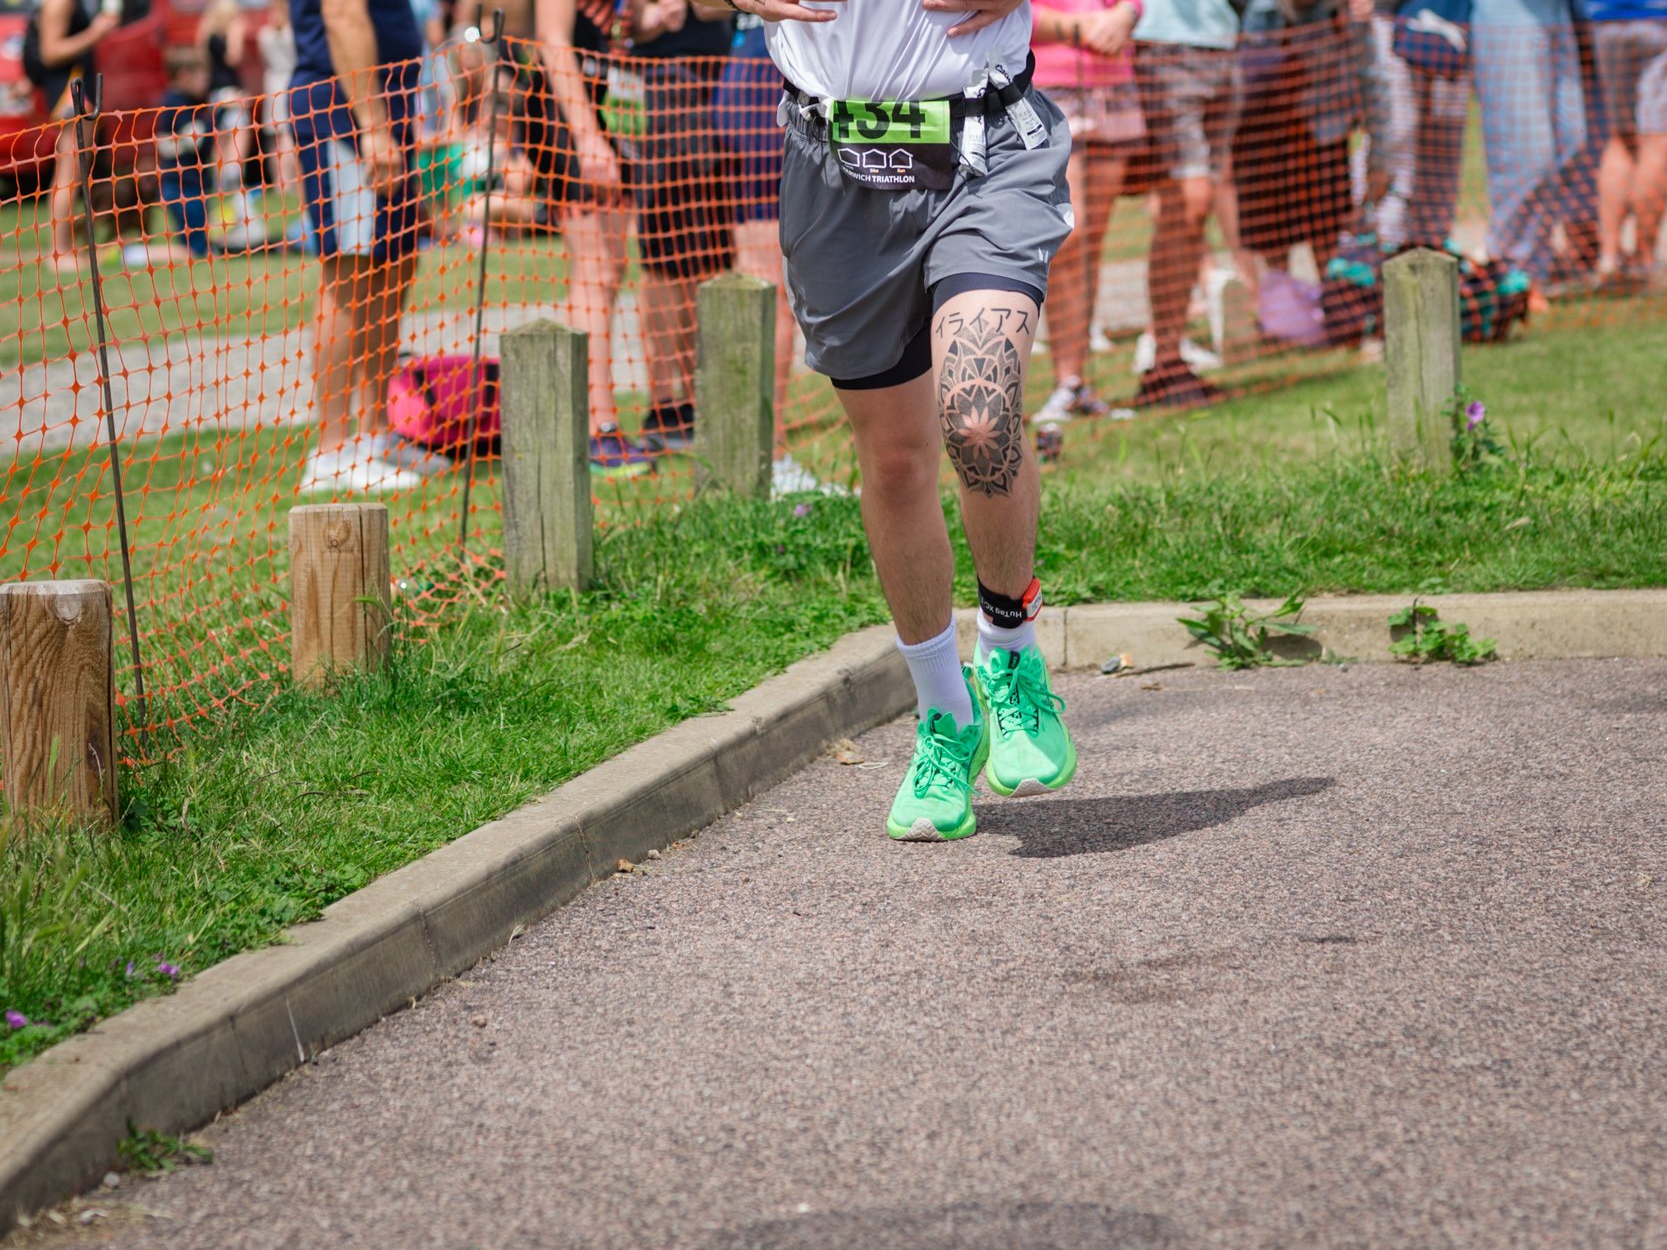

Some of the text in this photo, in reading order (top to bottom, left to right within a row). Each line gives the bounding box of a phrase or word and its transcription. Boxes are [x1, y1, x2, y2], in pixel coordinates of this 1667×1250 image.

[872, 175, 915, 183] TRIATHLON
[935, 307, 1029, 338] イライアス
